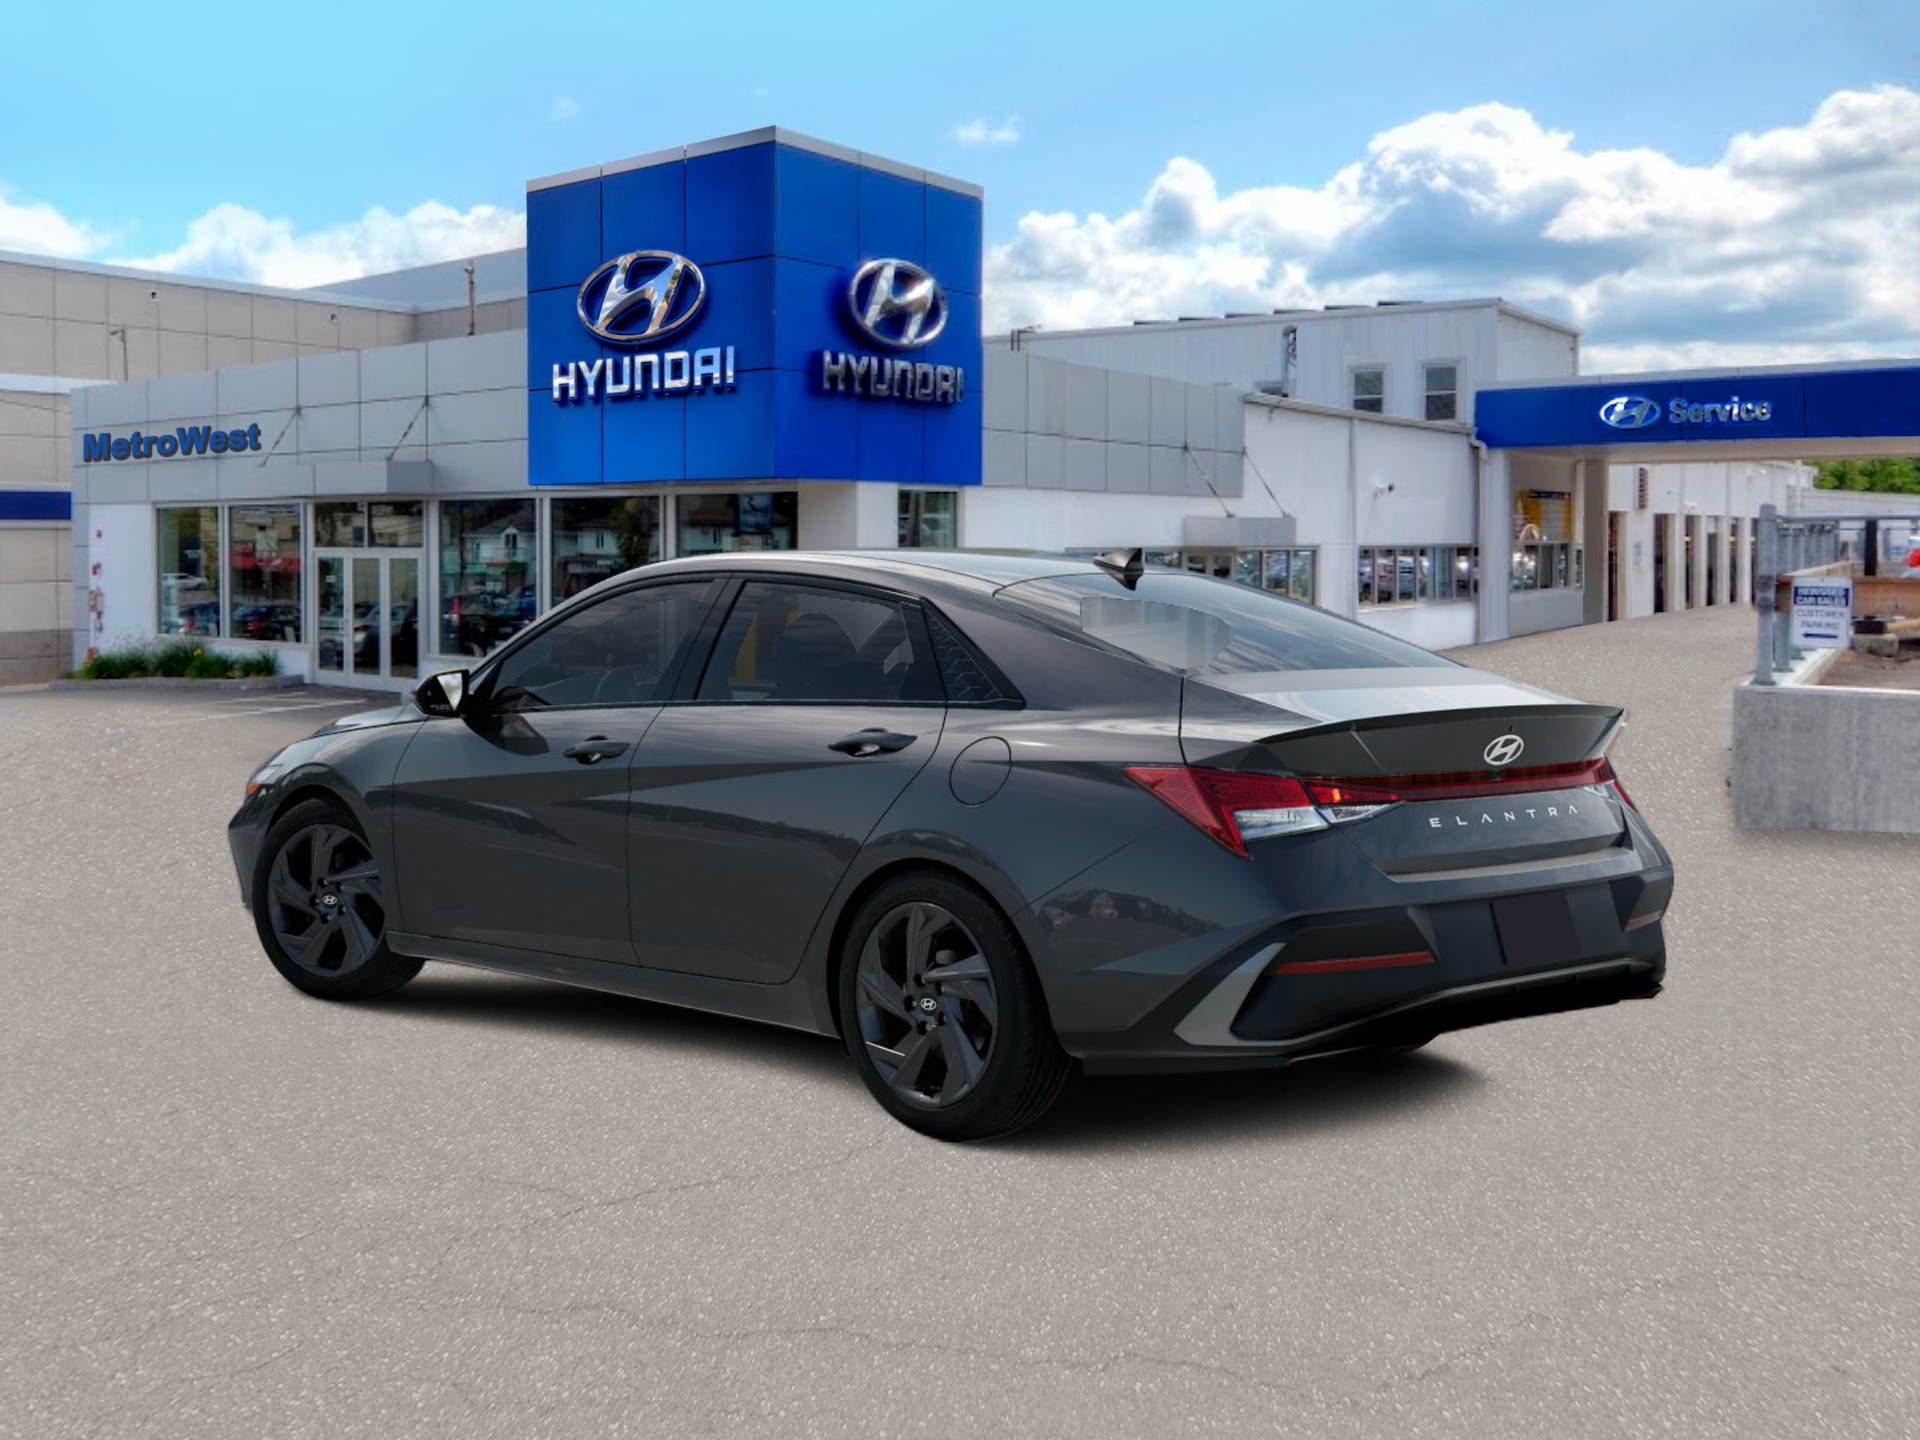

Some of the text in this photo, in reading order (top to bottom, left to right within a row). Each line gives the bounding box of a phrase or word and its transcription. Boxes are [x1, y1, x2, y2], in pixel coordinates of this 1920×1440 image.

[552, 345, 735, 401] HYUNDAI
[822, 349, 964, 403] HYUNDAI
[1669, 395, 1772, 424] Service
[83, 423, 262, 463] MetroWest
[1797, 609, 1844, 618] CUSTOMER
[1800, 621, 1839, 630] PARKING
[1428, 804, 1579, 828] ELANTRA
